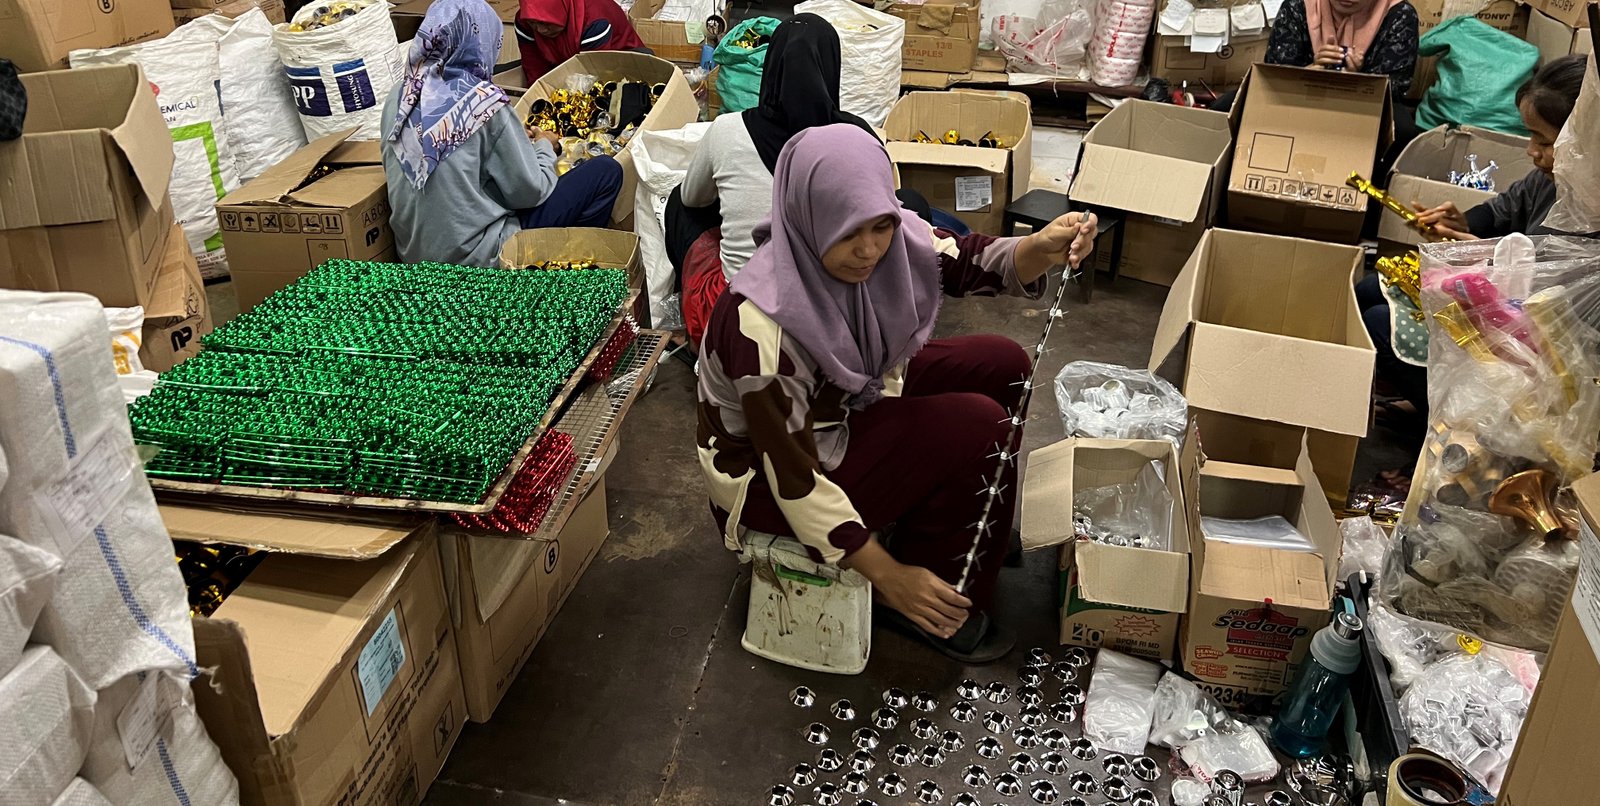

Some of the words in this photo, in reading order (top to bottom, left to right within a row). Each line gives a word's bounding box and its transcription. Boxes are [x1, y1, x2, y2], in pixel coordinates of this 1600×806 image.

[905, 49, 944, 58] STAPLES
[291, 85, 316, 109] PP
[346, 74, 363, 110] HYOSUNG
[1213, 615, 1310, 640] Sedaap
[1232, 646, 1281, 659] SELECTION
